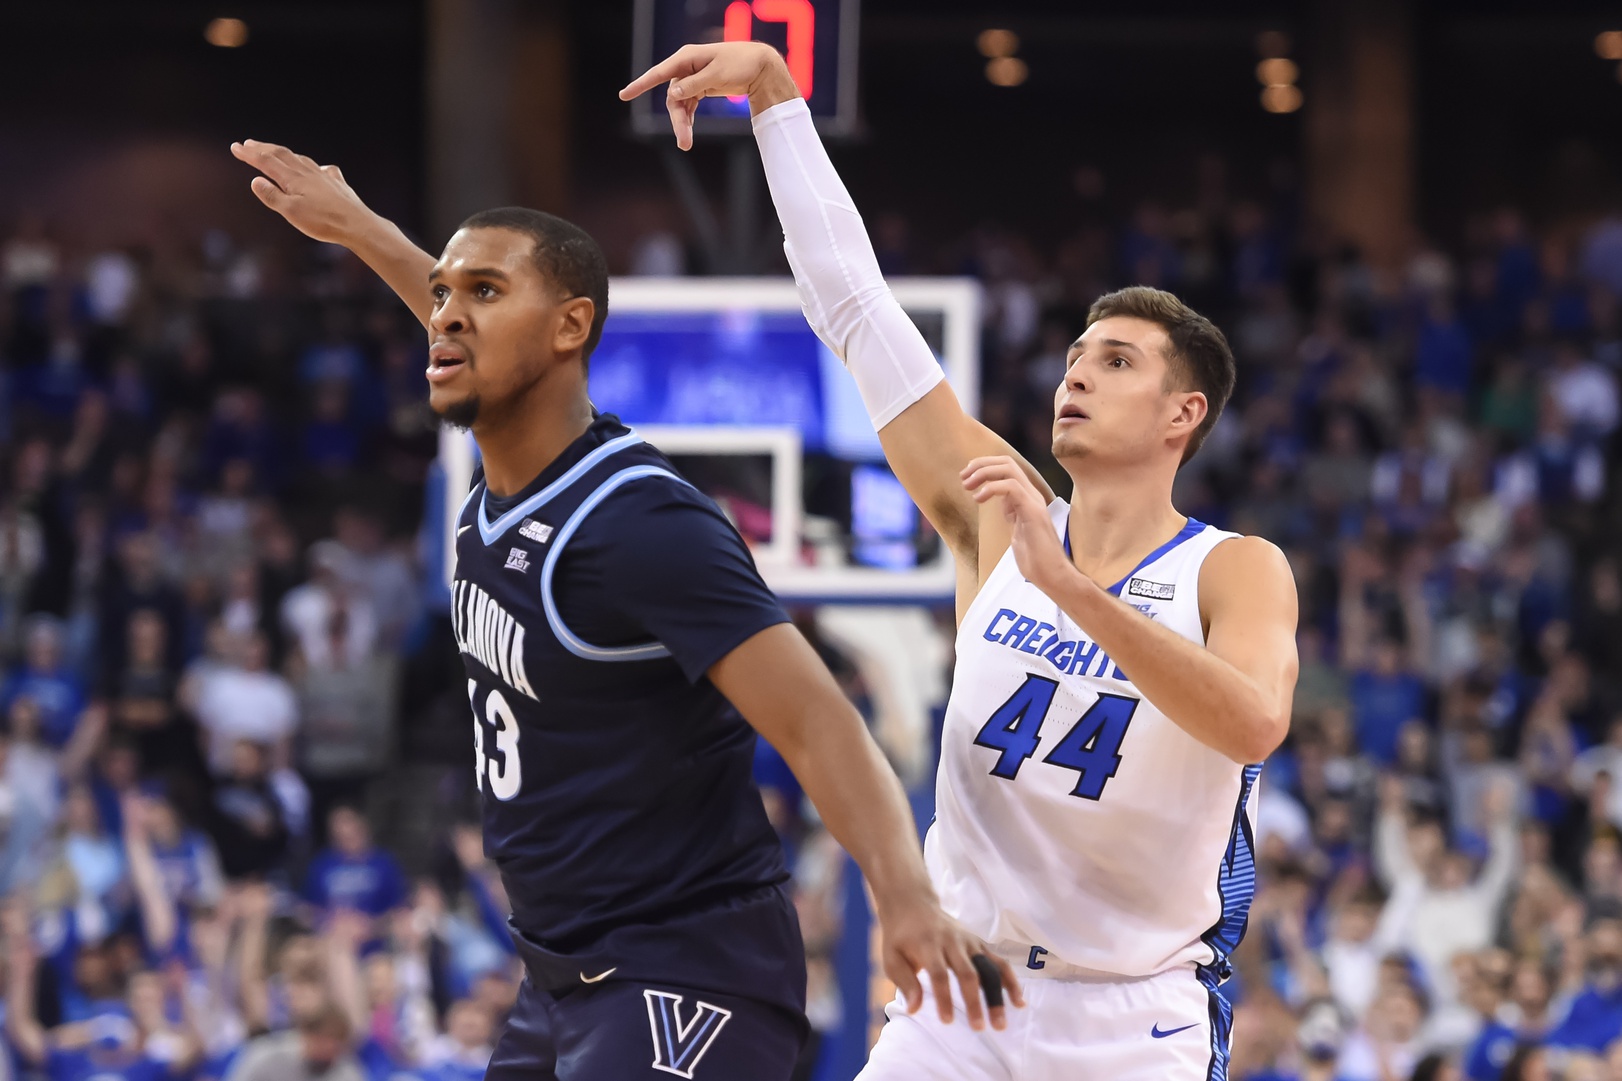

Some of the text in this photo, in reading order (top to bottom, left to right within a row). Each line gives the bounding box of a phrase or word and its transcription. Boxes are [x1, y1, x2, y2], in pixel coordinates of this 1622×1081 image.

[506, 556, 531, 570] EAST
[510, 547, 528, 560] BIG
[451, 580, 541, 703] LLANOVA
[973, 671, 1141, 802] 44
[1026, 945, 1049, 970] C
[643, 988, 732, 1080] V
